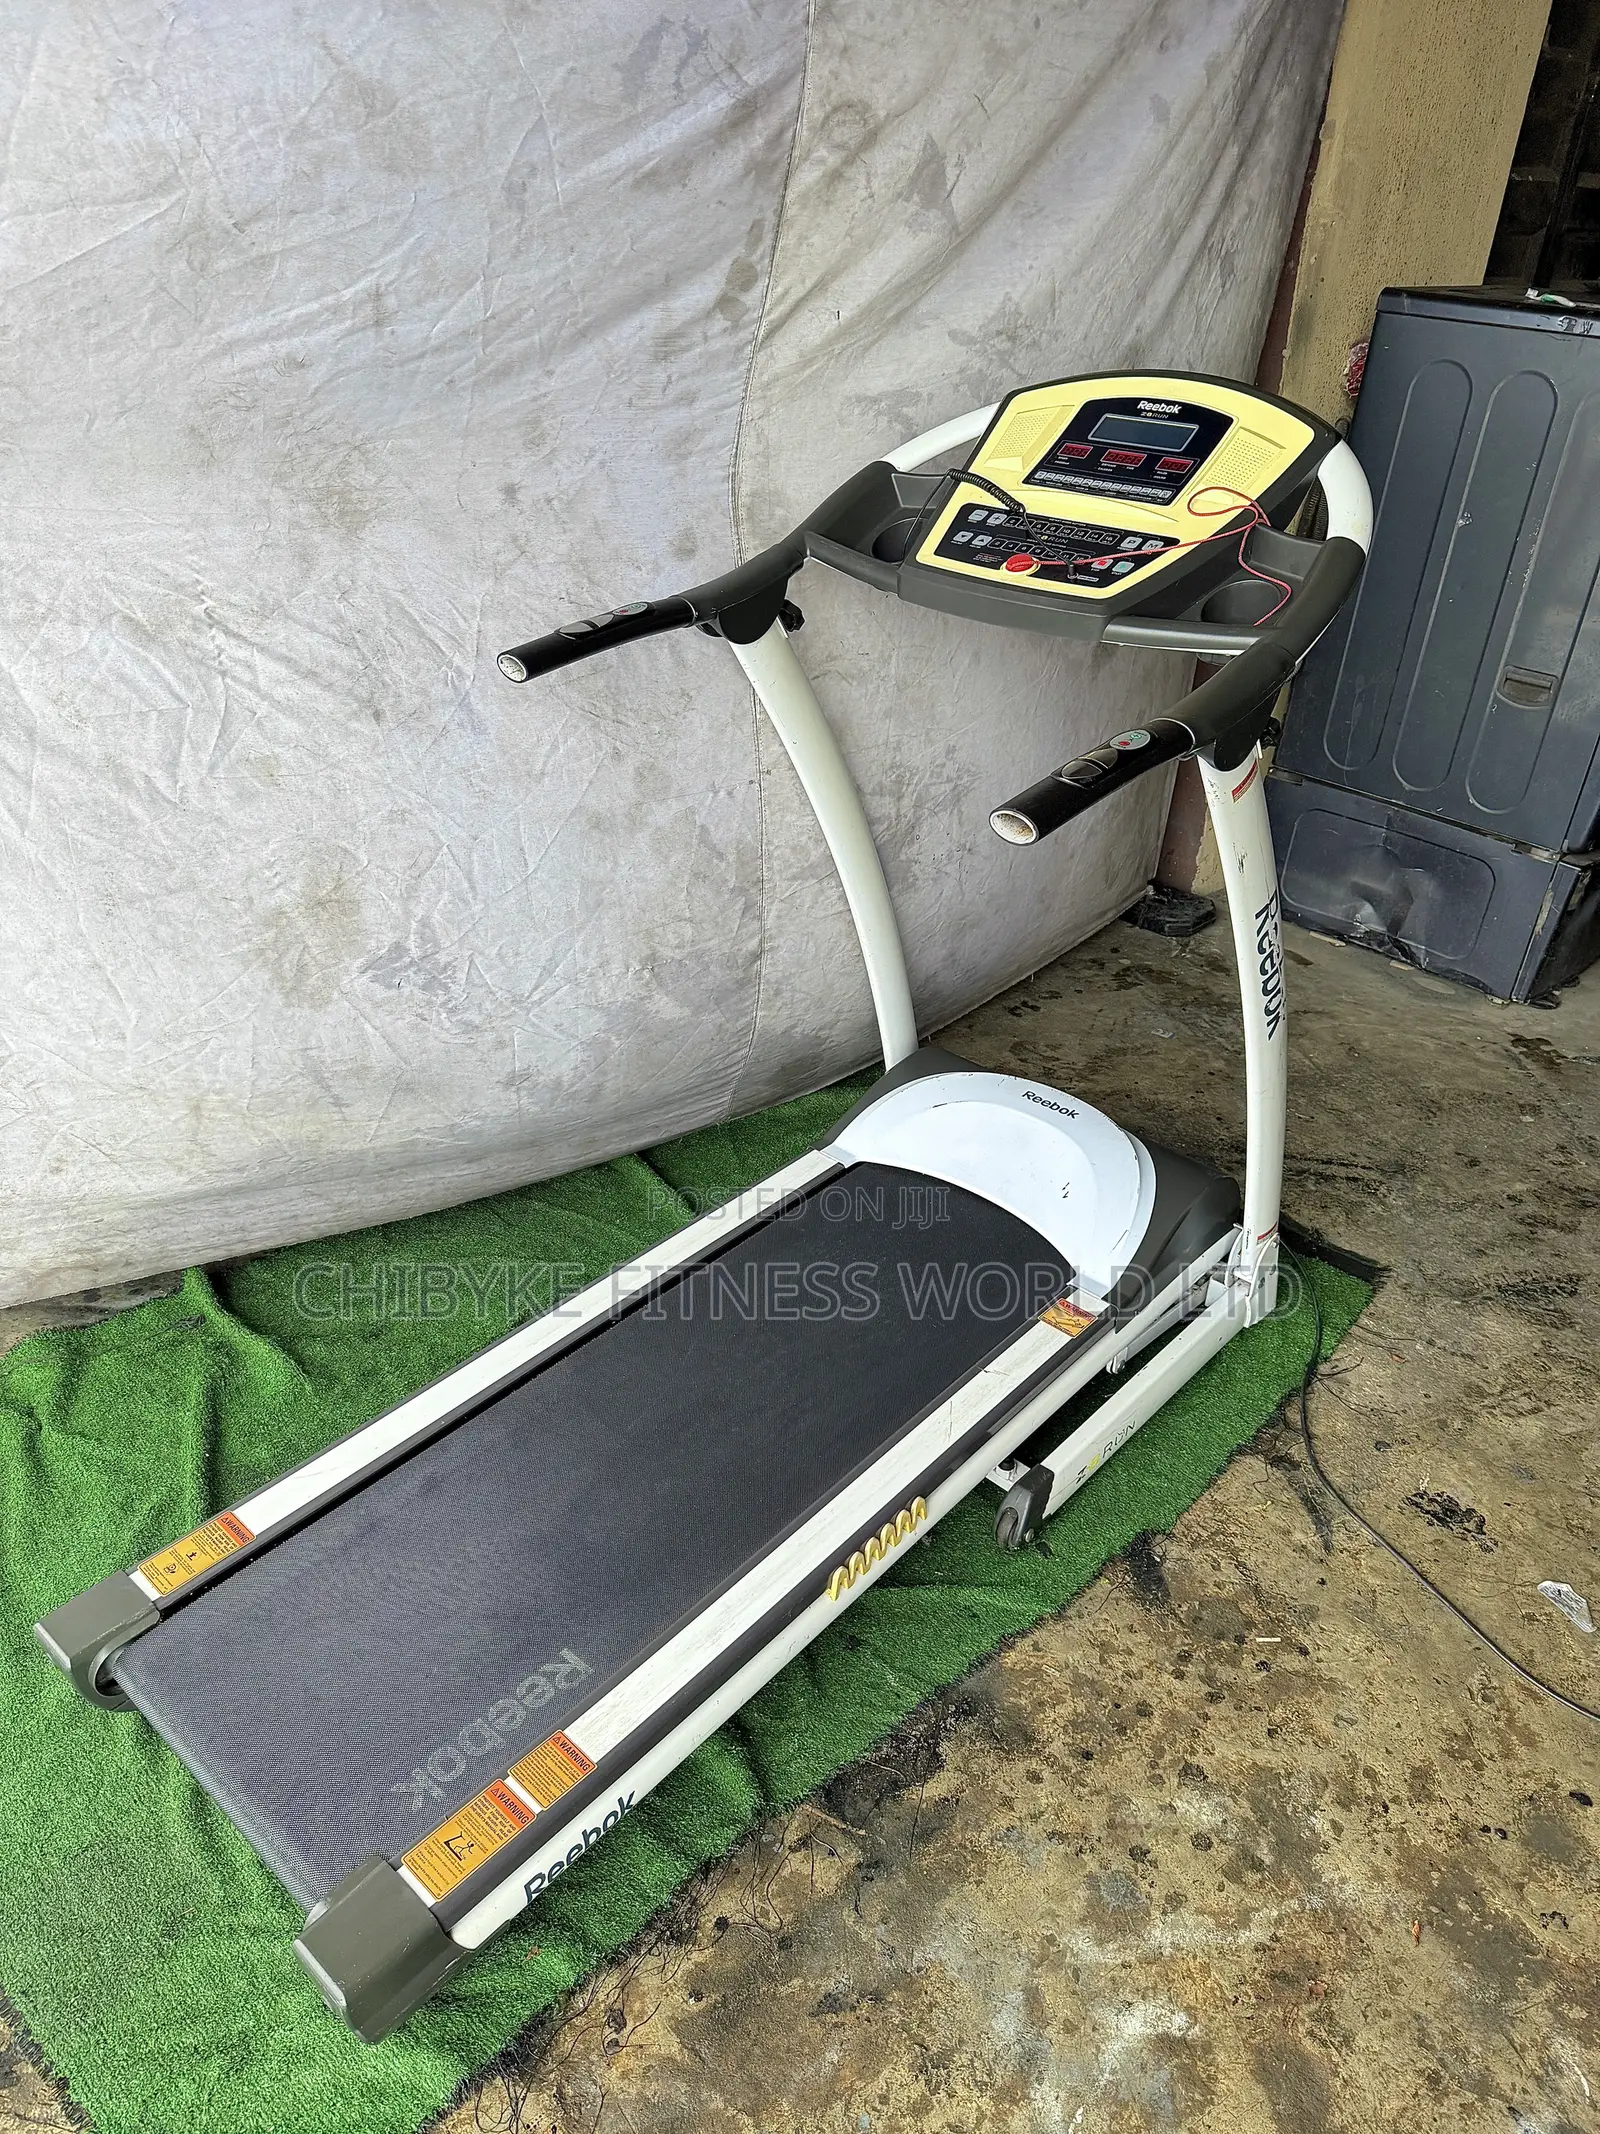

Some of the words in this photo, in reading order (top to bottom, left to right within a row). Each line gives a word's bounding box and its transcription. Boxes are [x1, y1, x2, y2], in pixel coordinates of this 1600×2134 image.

[1137, 400, 1183, 414] Reebok
[1022, 1090, 1080, 1119] Reebok
[226, 1520, 250, 1543] WARNING
[391, 1648, 595, 1810] Reebok
[560, 1740, 591, 1771] WARNING
[498, 1792, 529, 1824] WARNING
[524, 1790, 636, 1904] Reebok
